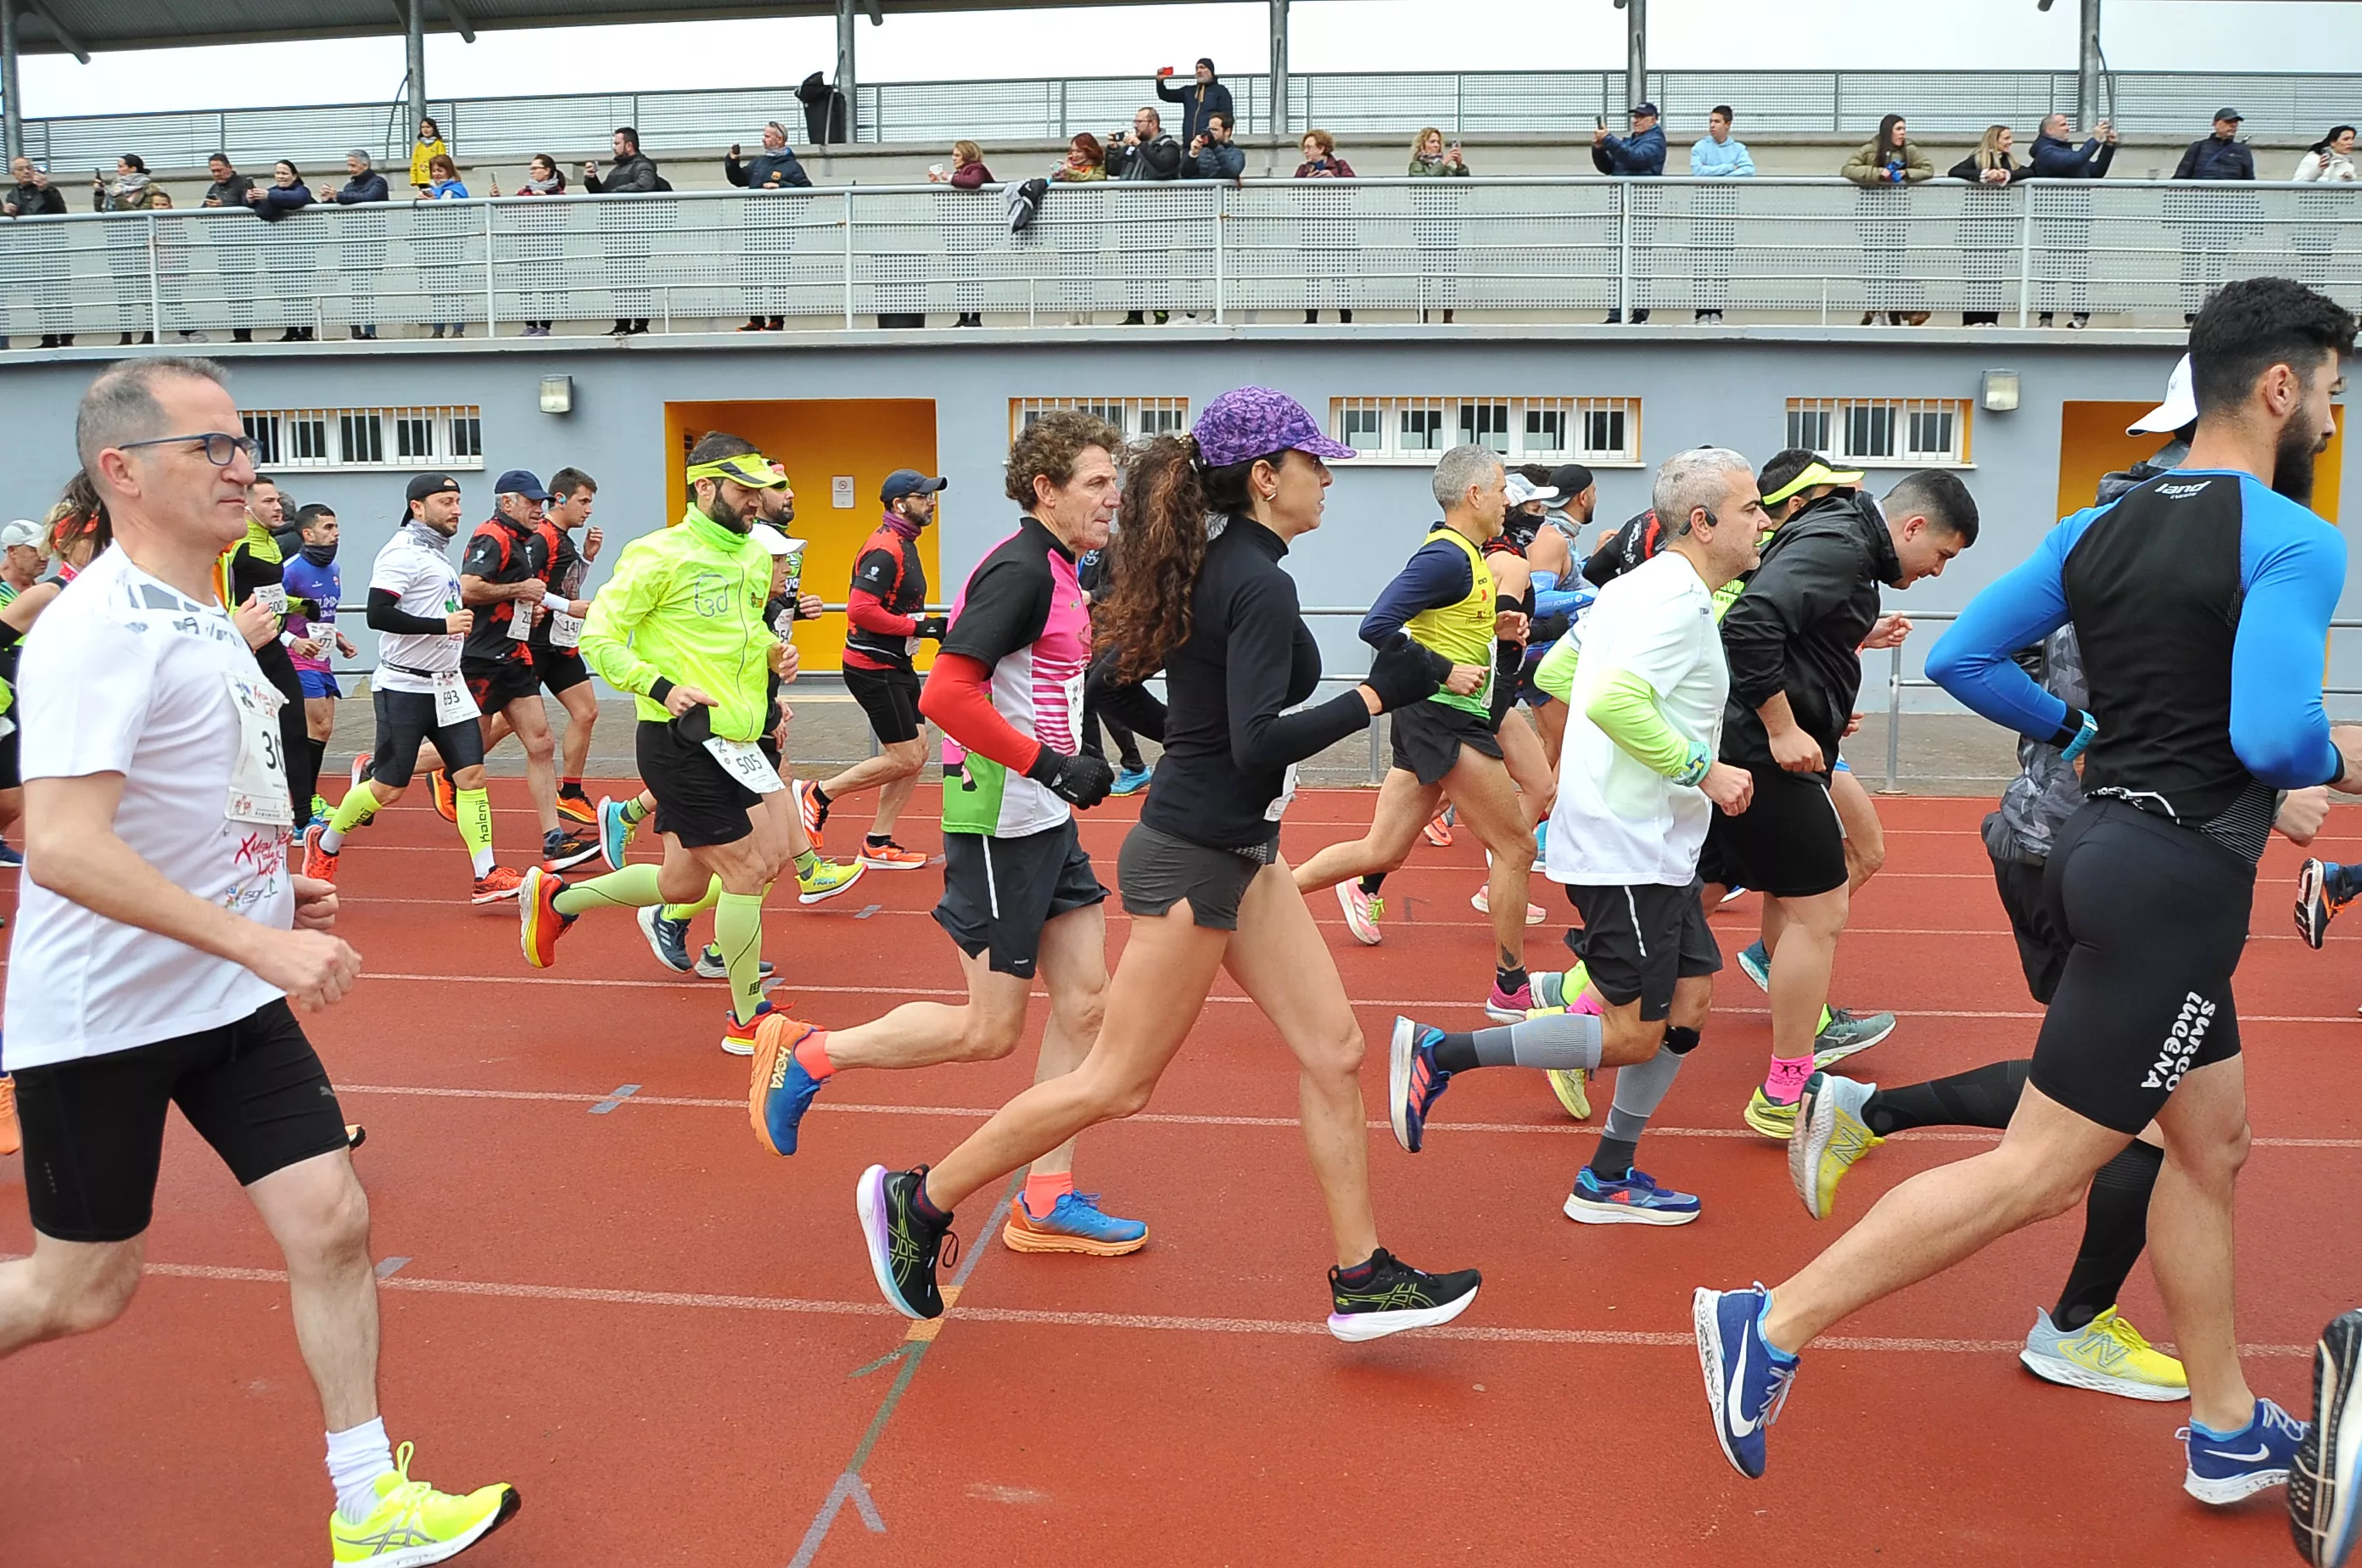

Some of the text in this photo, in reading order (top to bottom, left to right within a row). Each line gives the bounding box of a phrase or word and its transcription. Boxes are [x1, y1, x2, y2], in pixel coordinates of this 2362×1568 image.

[2155, 480, 2213, 495] land
[736, 753, 763, 776] 505
[2141, 991, 2202, 1089] LUCENA
[2165, 1000, 2216, 1092] SURCO
[770, 1045, 792, 1089] HOKA
